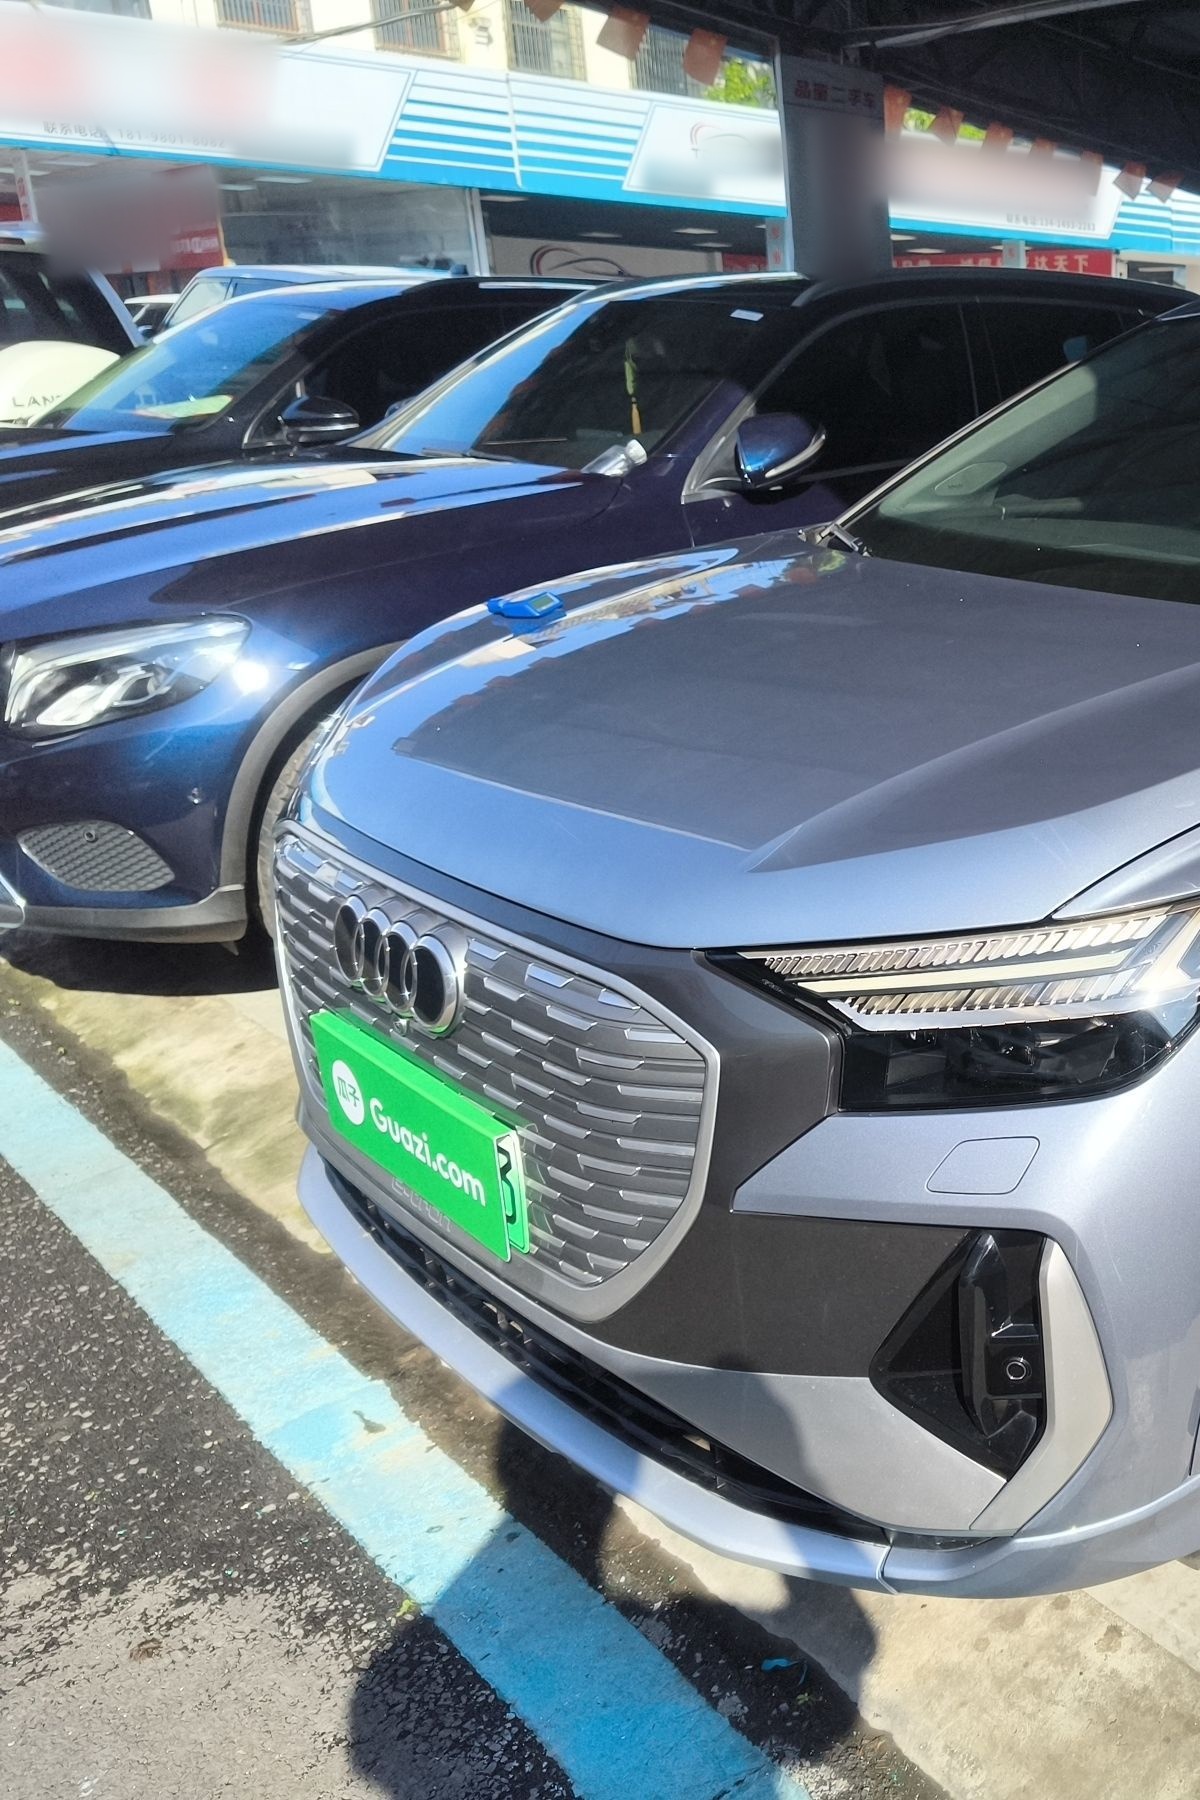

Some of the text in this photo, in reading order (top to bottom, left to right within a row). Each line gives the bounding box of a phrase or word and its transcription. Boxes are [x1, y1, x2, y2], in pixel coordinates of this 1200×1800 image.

[11, 394, 61, 408] LAN
[336, 1075, 361, 1109] 瓜子
[369, 1096, 487, 1208] Guazi.com
